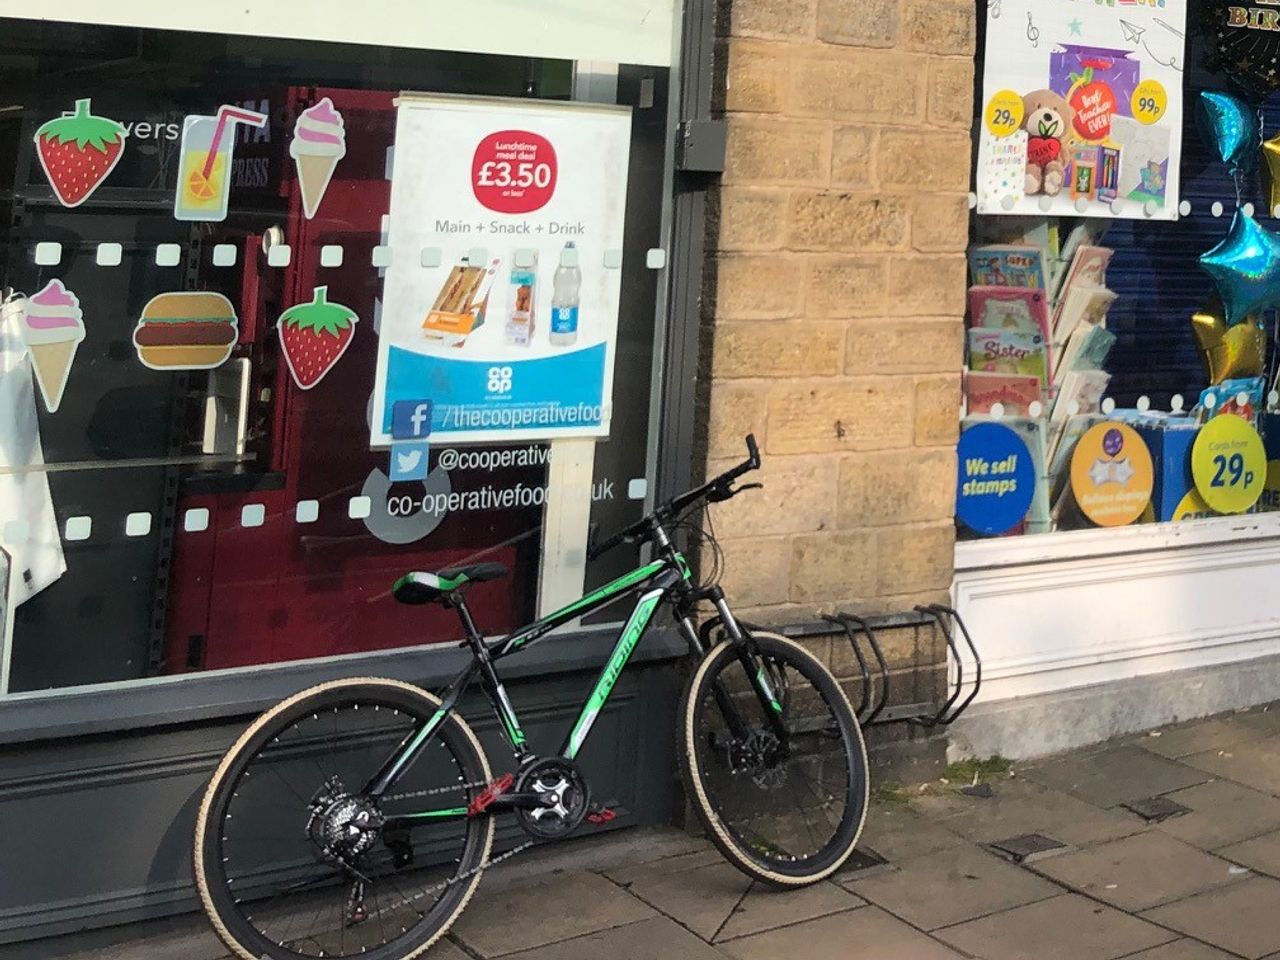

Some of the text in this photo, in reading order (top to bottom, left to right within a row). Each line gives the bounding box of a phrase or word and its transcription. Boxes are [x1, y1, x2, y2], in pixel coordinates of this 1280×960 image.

[1139, 97, 1160, 116] 99p
[993, 109, 1015, 129] 29p
[495, 141, 538, 151] Lunchtime
[477, 161, 551, 188] £3.50
[435, 220, 471, 233] Main
[490, 221, 530, 234] Snack
[549, 222, 585, 234] Drink
[984, 341, 1030, 359] Sister
[965, 455, 1017, 476] We sell
[1210, 453, 1254, 489] 29p
[963, 478, 1017, 498] stamps
